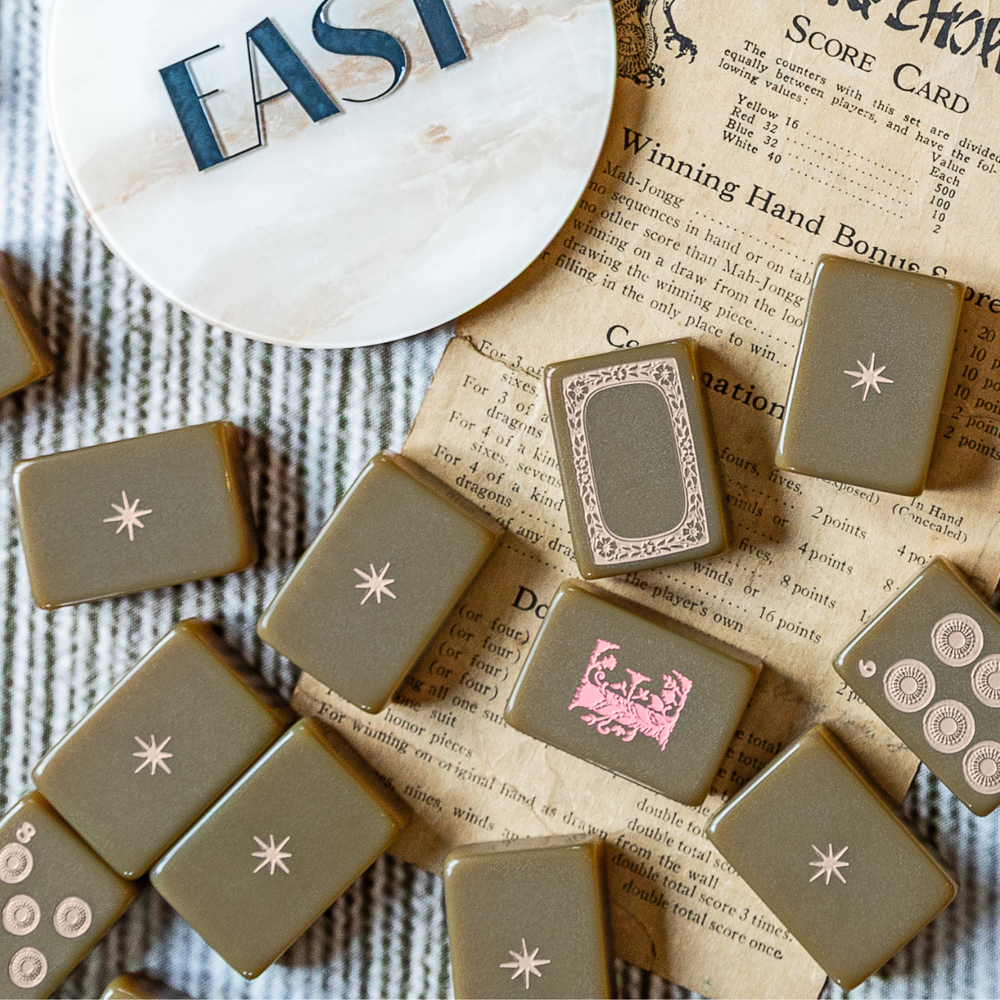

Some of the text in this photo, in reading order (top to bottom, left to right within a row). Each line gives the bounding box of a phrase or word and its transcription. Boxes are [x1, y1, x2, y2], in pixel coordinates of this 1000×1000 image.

[718, 57, 965, 175] lowing values: Value
[723, 48, 768, 73] equally
[775, 68, 823, 98] between
[885, 120, 909, 135] and
[915, 130, 943, 151] have
[951, 148, 970, 163] the
[976, 158, 996, 173] fol-
[737, 93, 955, 198] Yellow 16 500
[744, 39, 766, 58] The
[775, 57, 826, 84] counters
[836, 83, 862, 101] with
[872, 99, 894, 115] this
[902, 114, 920, 127] set
[929, 126, 949, 140] are
[624, 127, 740, 202] Winning
[745, 184, 825, 235] Hand
[723, 129, 941, 234] White 40 2
[725, 117, 945, 222] Blue 32 10
[730, 105, 950, 210] Red 32 100
[929, 165, 959, 186] Each
[600, 210, 638, 230] other
[643, 228, 680, 250] score
[685, 245, 716, 266] than
[722, 258, 804, 306] Mah-Jongg
[961, 364, 978, 381] 10
[602, 161, 684, 208] Mah-Jongg
[976, 326, 996, 342] 20
[611, 192, 680, 227] sequences
[685, 219, 699, 236] in
[703, 228, 741, 254] hand
[745, 251, 762, 263] or
[766, 260, 783, 274] on
[969, 345, 987, 362] 10
[555, 254, 597, 282] filling
[601, 274, 616, 290] in
[621, 284, 643, 302] the
[649, 299, 681, 319] only
[684, 315, 723, 337] place
[728, 332, 743, 346] to
[942, 425, 954, 439] 2
[564, 236, 622, 272] drawing
[626, 264, 649, 282] the
[656, 279, 712, 312] winning
[951, 405, 963, 420] 2
[633, 246, 650, 260] on
[655, 256, 664, 267] a
[670, 261, 707, 285] draw
[713, 278, 748, 304] from
[753, 298, 776, 316] the
[953, 383, 970, 401] 10
[448, 410, 772, 565] For 4 of a fives,
[462, 374, 789, 527] For 3 of a or
[486, 405, 893, 590] dragons 4 points 8
[500, 372, 906, 556] sixes, 2 points 4
[720, 447, 802, 495] fours, fives,
[928, 504, 963, 527] Hand
[433, 444, 759, 597] For 4 of a kind winds or
[455, 474, 821, 643] dragons 16 points
[470, 440, 836, 608] sixes, 8 points
[516, 525, 743, 632] any the own
[427, 684, 449, 700] all
[15, 820, 37, 845] 8
[317, 701, 719, 889] For winning from the wall
[383, 708, 426, 735] honor
[428, 732, 471, 757] pieces
[627, 817, 674, 846] double
[677, 840, 711, 863] total
[429, 710, 456, 727] suit
[636, 797, 683, 827] double
[453, 806, 746, 942] winds double total score
[662, 875, 749, 920] total score 3
